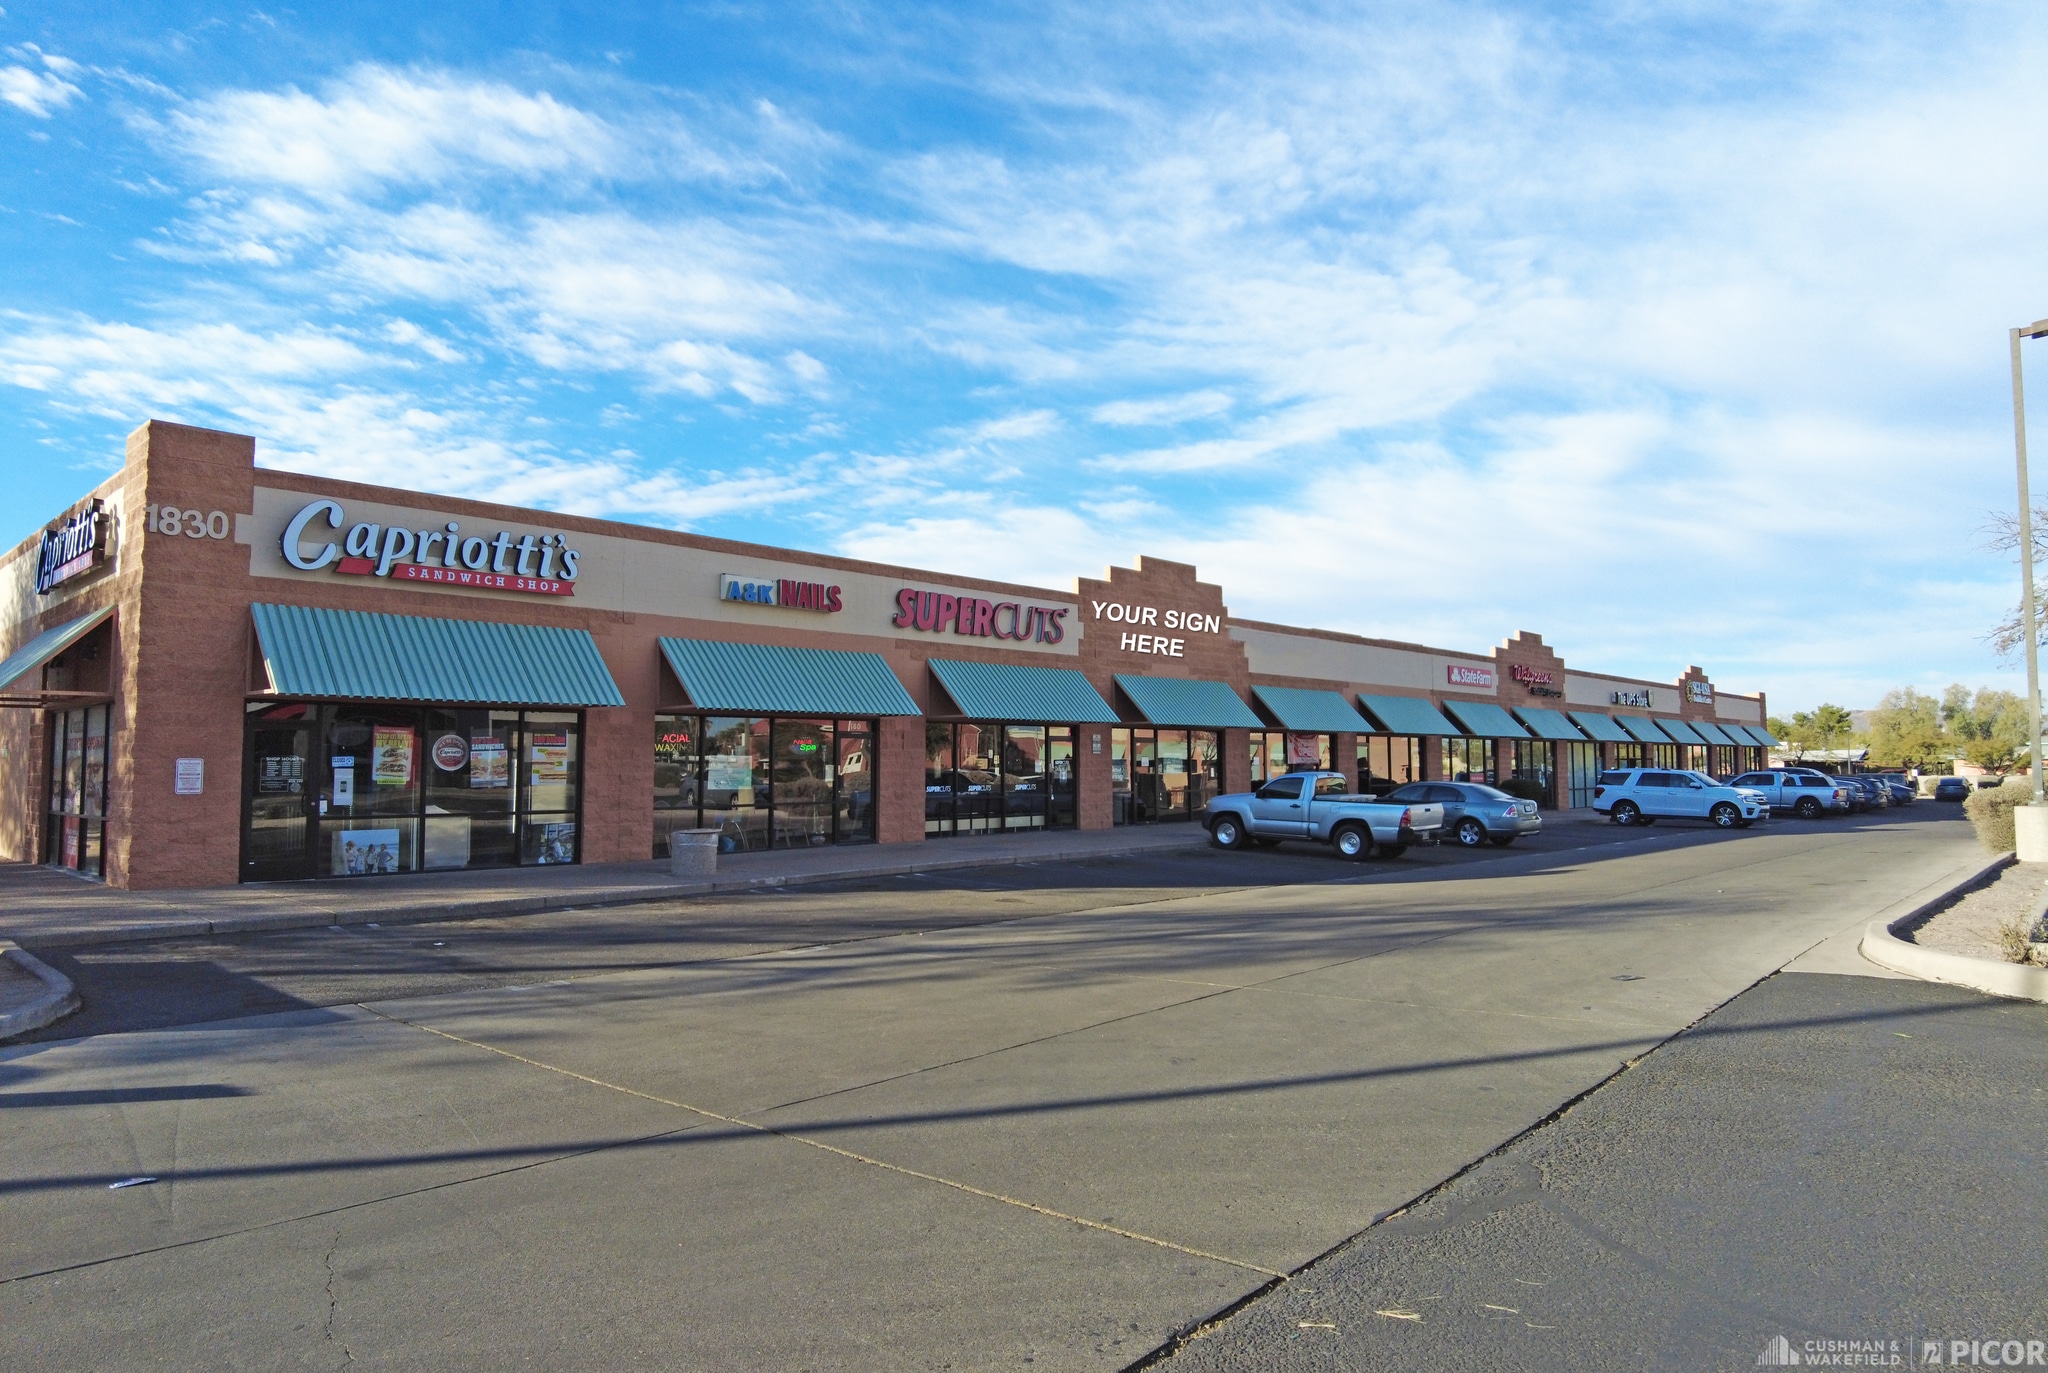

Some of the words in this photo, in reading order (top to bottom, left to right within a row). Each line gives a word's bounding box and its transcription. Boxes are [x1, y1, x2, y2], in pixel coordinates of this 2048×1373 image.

[144, 503, 229, 540] 1830
[35, 498, 99, 594] Capriotti's
[280, 499, 582, 581] Capriotti's
[407, 566, 506, 587] SANDWICH
[517, 578, 561, 592] SHOP
[727, 579, 775, 605] A&K
[777, 579, 843, 613] NAILS
[893, 588, 1068, 645] SUPERCUTS
[925, 785, 952, 793] SUPERCUTS
[967, 784, 992, 792] SUPERCUTS
[1014, 783, 1037, 791] SUPERCUTS
